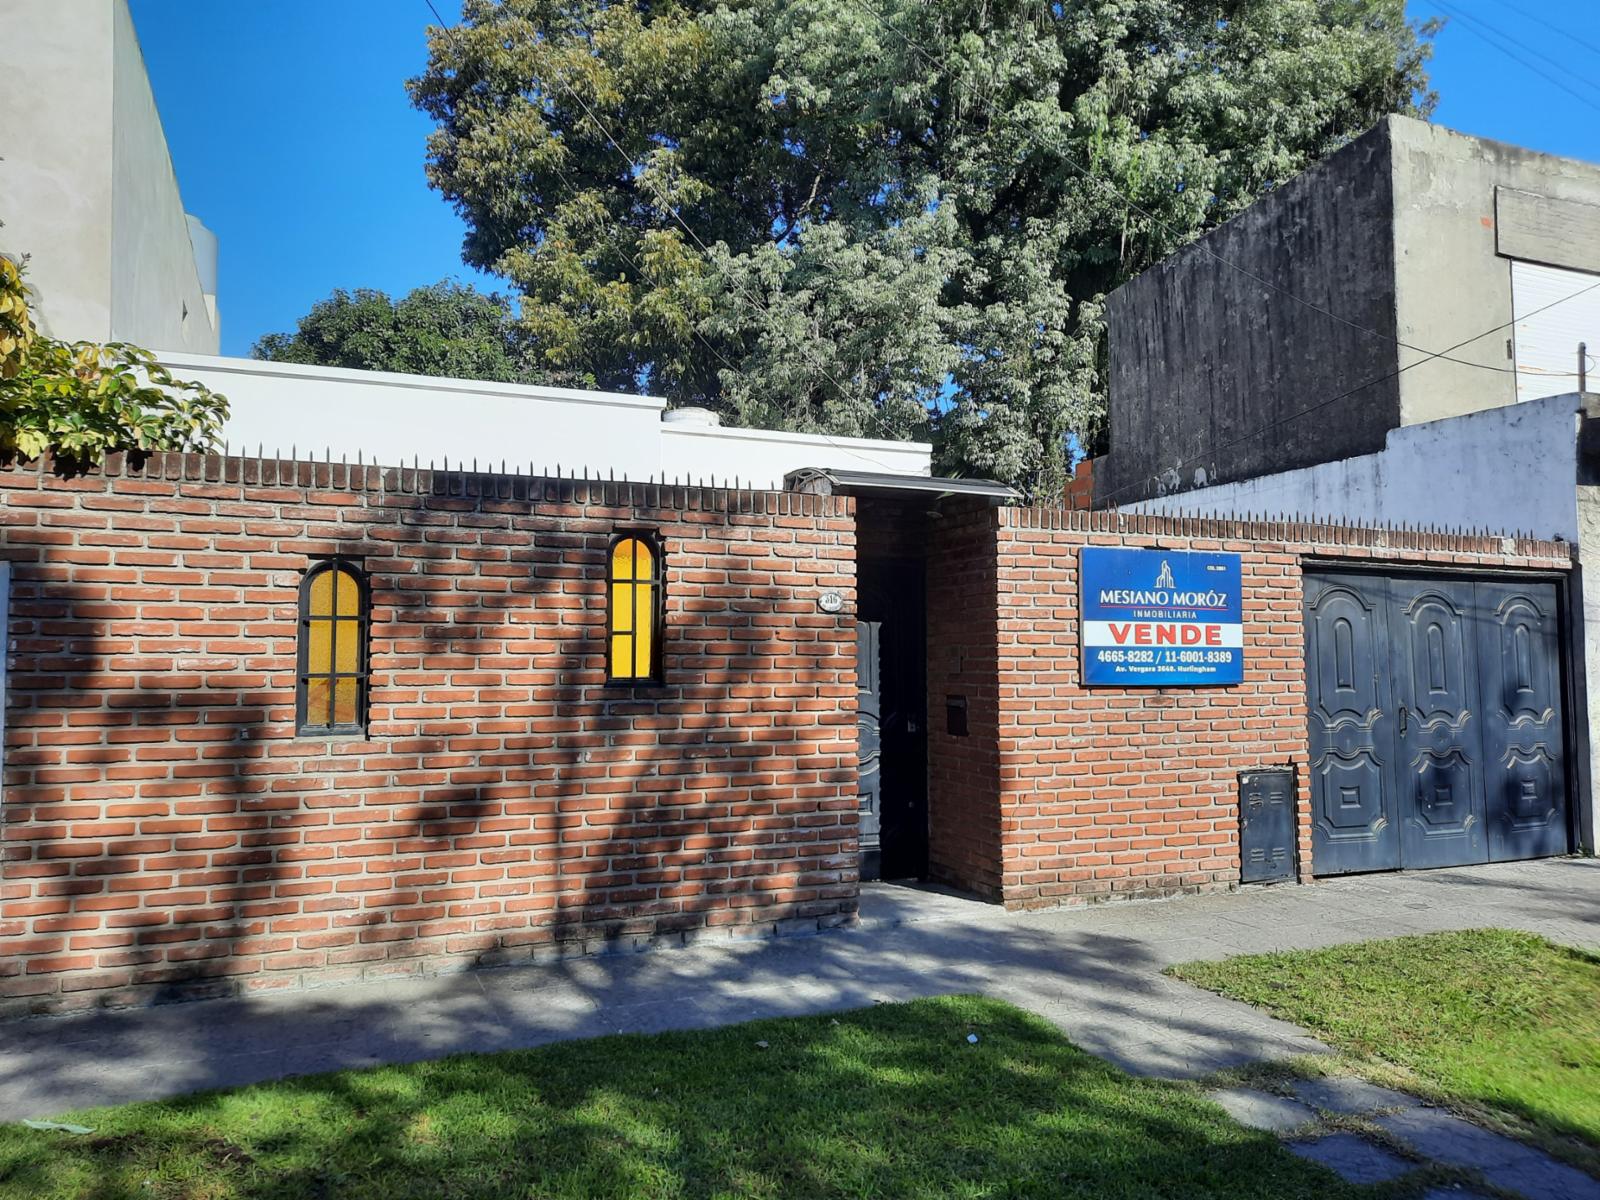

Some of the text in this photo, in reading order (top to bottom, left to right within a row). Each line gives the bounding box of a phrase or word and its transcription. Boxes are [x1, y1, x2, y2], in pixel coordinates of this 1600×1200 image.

[1100, 590, 1227, 607] MESIANO MORÓZ
[1133, 610, 1197, 619] INMOBILIARIA
[1108, 623, 1222, 646] VENDE
[1097, 650, 1232, 665] 4665-8282 / 11-6001-8389
[1115, 665, 1127, 673] Av.
[1128, 665, 1156, 674] Vergara
[1177, 665, 1217, 674] Hurlingham
